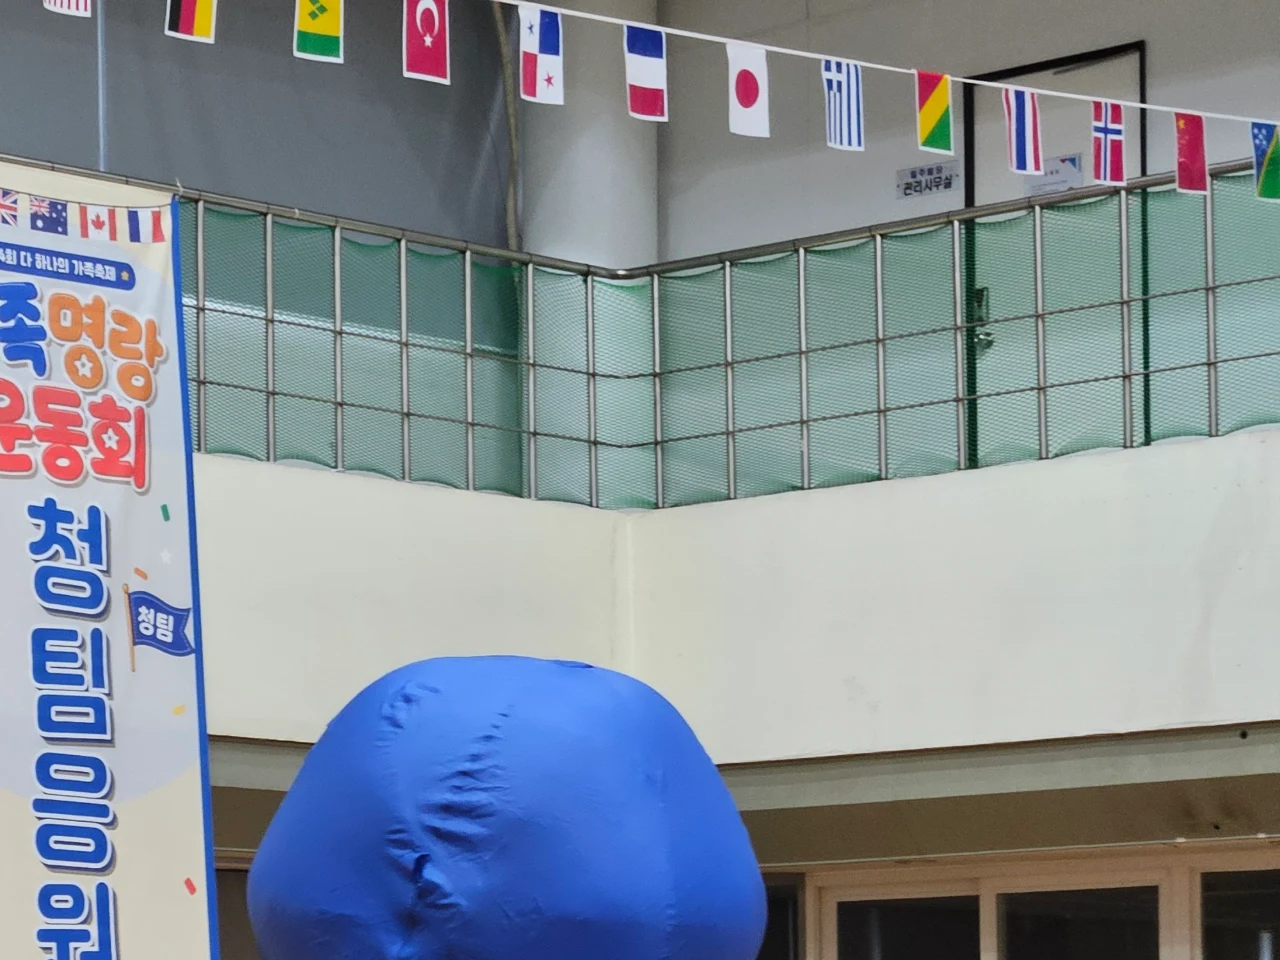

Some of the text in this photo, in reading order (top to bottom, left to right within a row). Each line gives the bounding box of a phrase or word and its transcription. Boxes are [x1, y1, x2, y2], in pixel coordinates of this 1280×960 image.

[21, 251, 33, 268] 다
[35, 253, 70, 274] 하나의
[72, 260, 117, 282] 가족축제
[138, 604, 175, 643] 청팀
